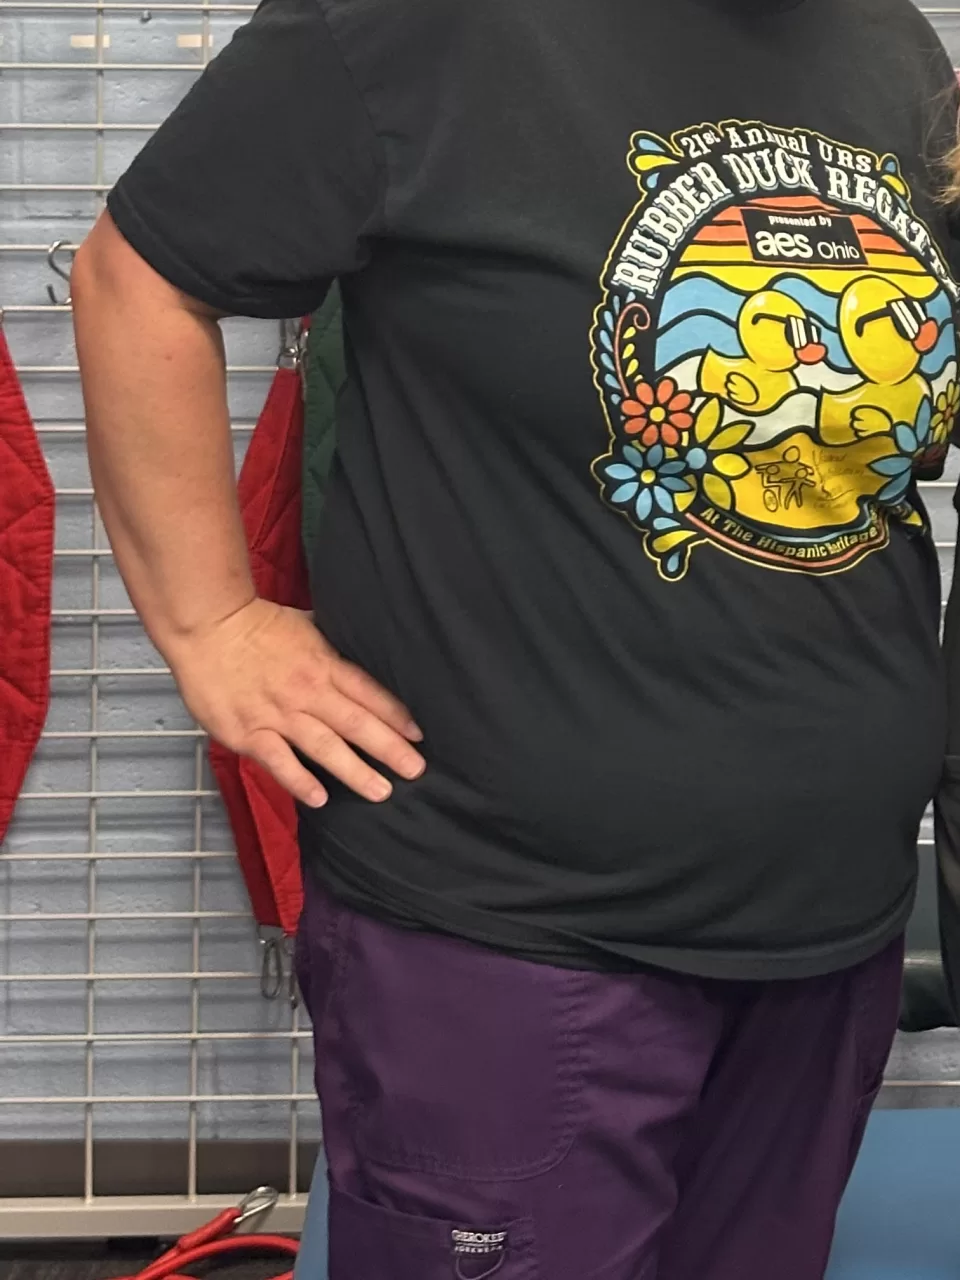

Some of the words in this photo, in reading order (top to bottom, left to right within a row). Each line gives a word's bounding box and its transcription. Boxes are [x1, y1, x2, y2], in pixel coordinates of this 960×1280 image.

[680, 130, 721, 159] 21st
[818, 139, 872, 173] URS
[611, 161, 733, 299] RUBBER
[723, 148, 820, 195] DUCK
[768, 215, 817, 227] presented
[818, 215, 832, 227] by
[755, 230, 814, 258] aes
[817, 241, 860, 260] Ohio
[700, 507, 721, 526] At
[724, 521, 754, 542] The
[757, 536, 828, 559] Hispanic
